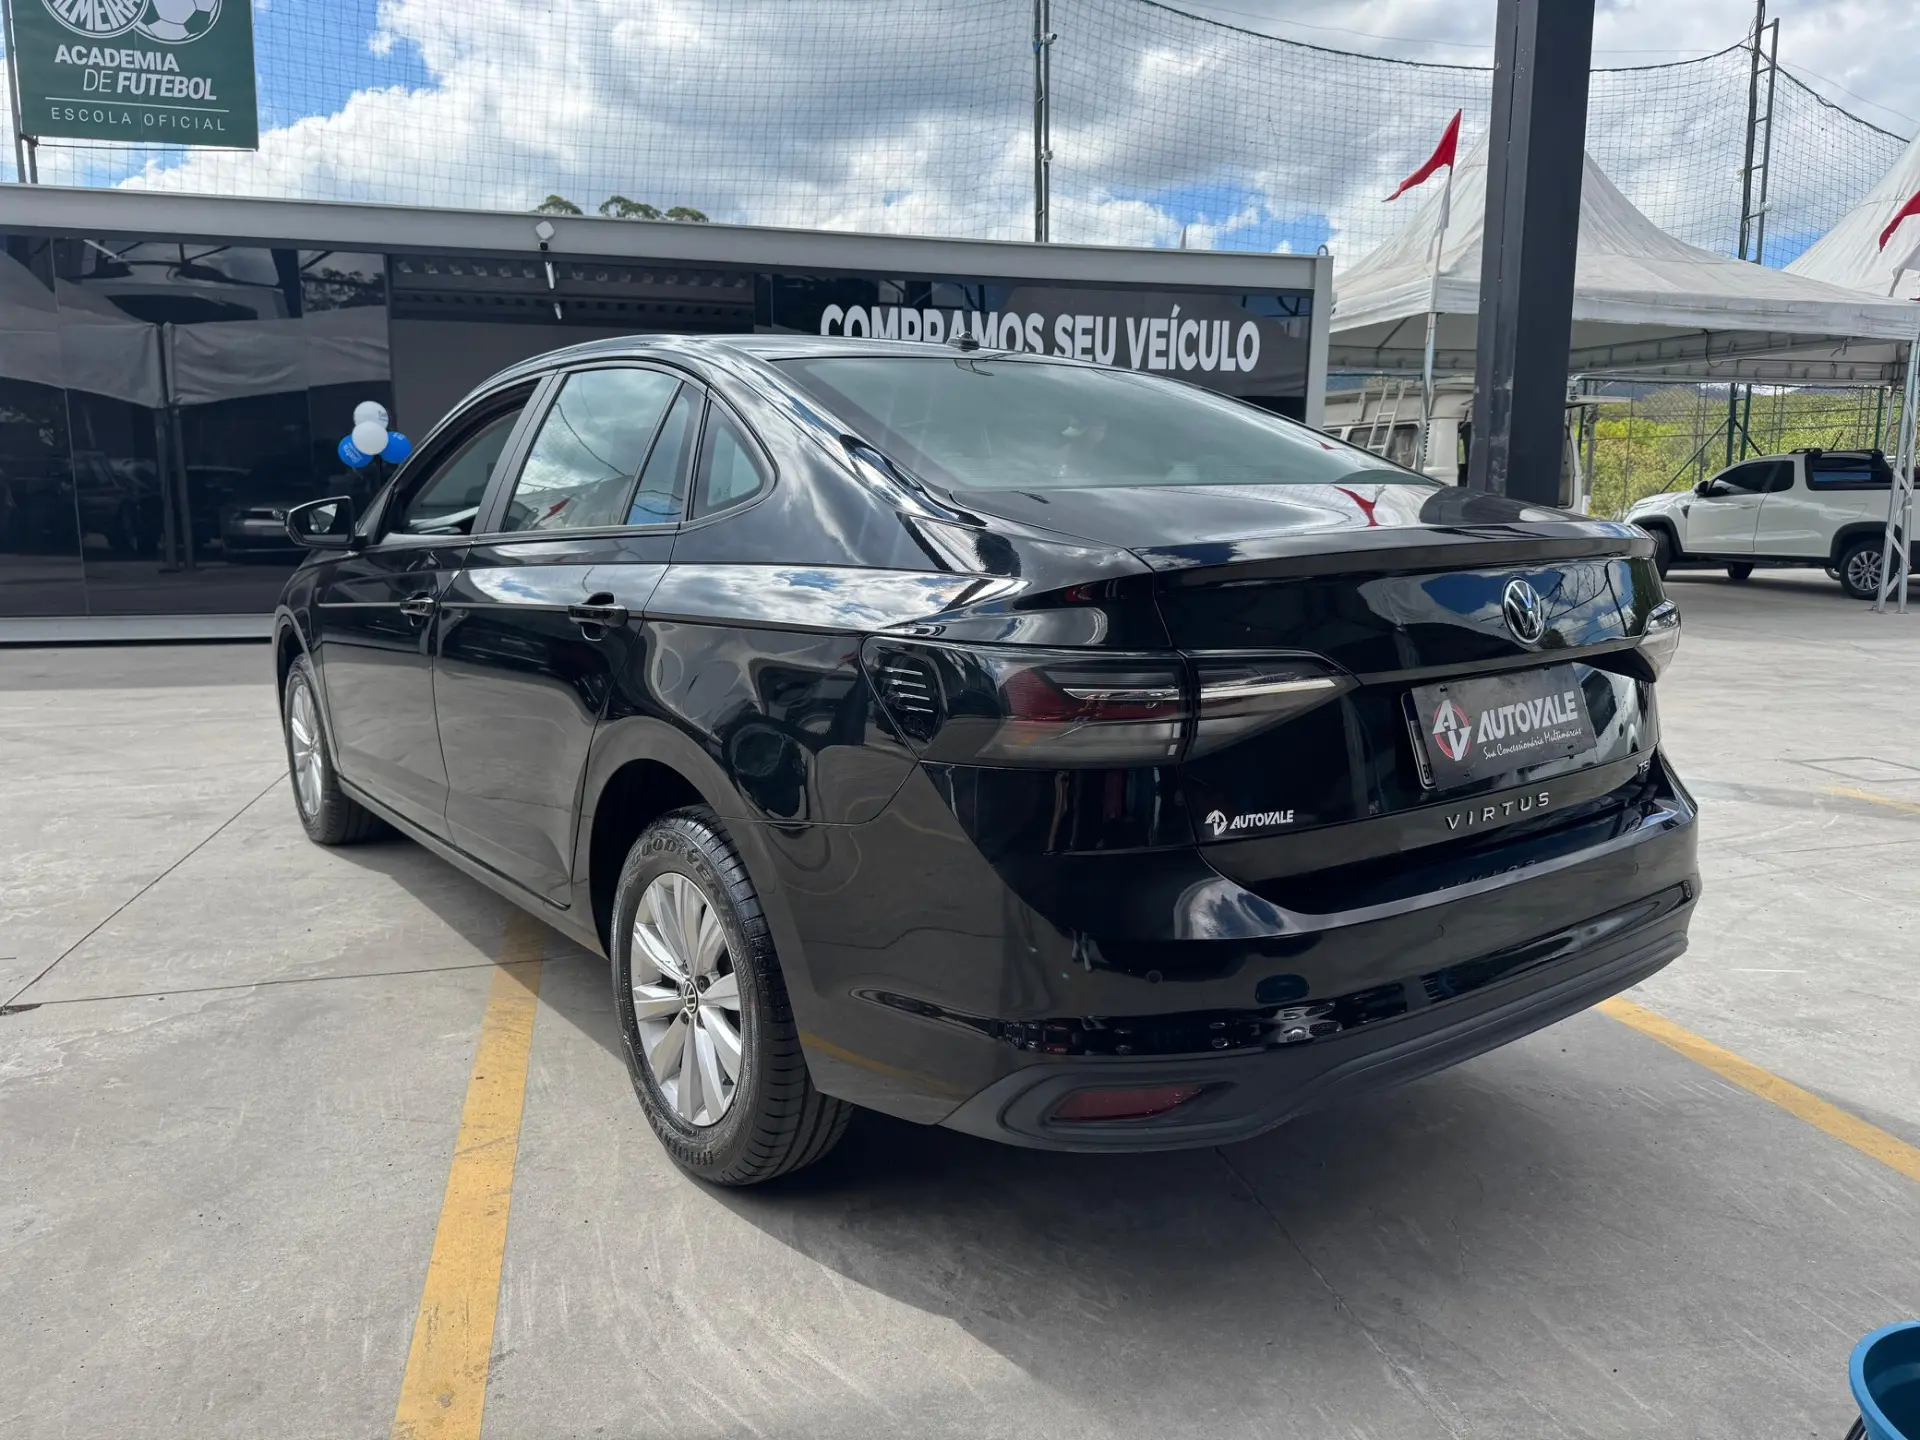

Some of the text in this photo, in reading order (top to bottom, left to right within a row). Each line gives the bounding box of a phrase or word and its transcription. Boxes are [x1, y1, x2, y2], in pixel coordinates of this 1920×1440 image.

[54, 44, 180, 73] ACADEMIA
[83, 69, 217, 101] DE FUTEBOL
[51, 107, 226, 131] ESCOLA OFICIAL
[1053, 313, 1117, 366] SEU
[1126, 303, 1260, 373] VEÍCULO
[1477, 690, 1579, 744] AUTOVALE
[1483, 747, 1497, 760] Sua
[1229, 809, 1295, 830] AUTOVALE
[1445, 791, 1550, 830] VIRTUS
